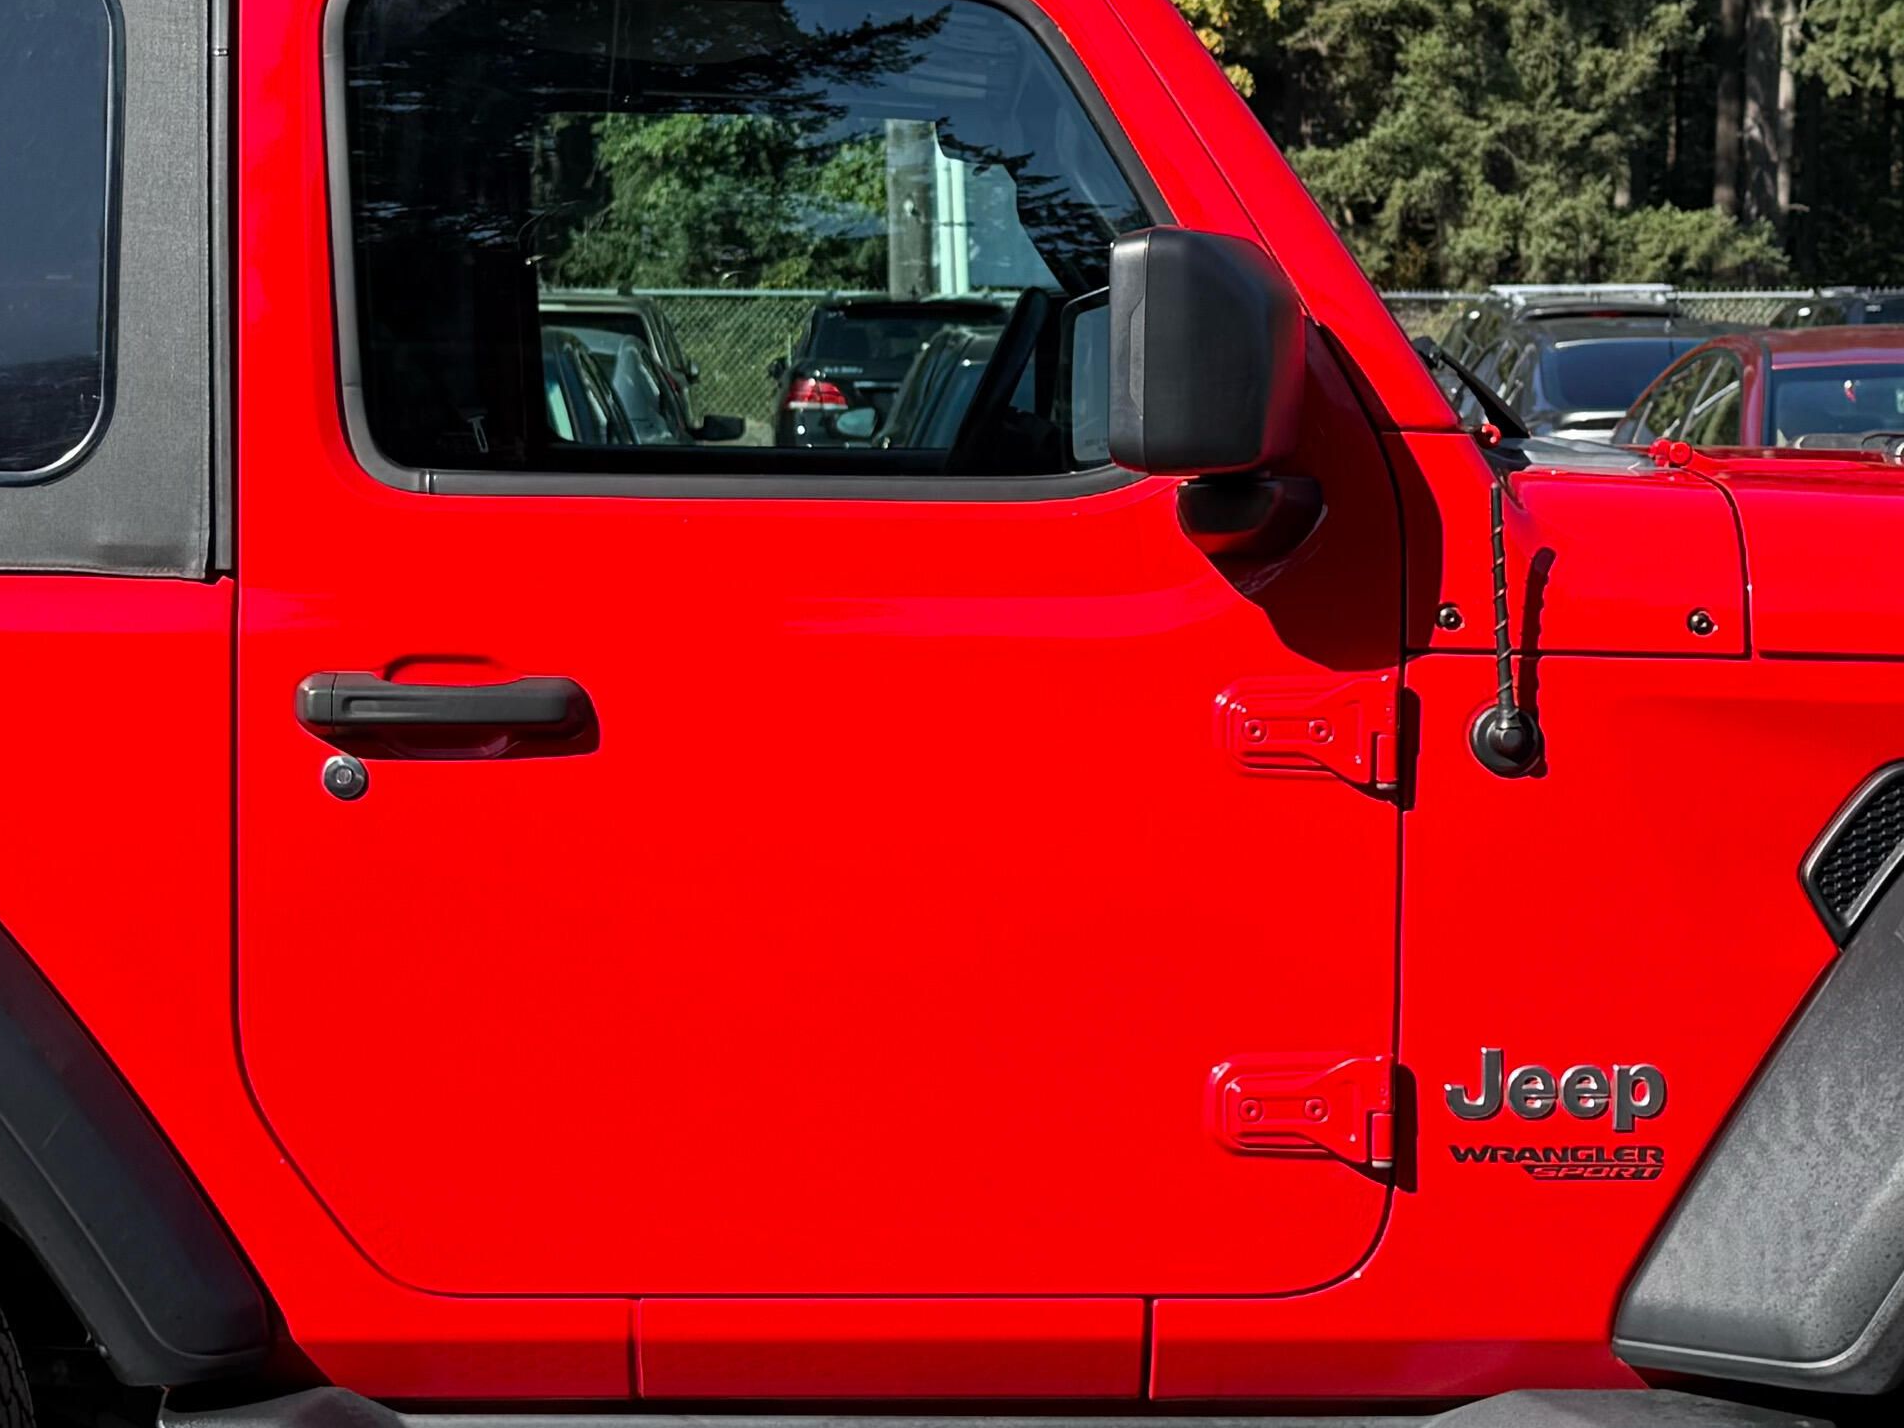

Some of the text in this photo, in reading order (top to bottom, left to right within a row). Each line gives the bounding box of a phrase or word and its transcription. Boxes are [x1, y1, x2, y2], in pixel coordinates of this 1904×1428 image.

[1444, 1047, 1668, 1133] Jeep
[1448, 1145, 1665, 1164] WRANGLER
[1533, 1166, 1662, 1180] SPORT
